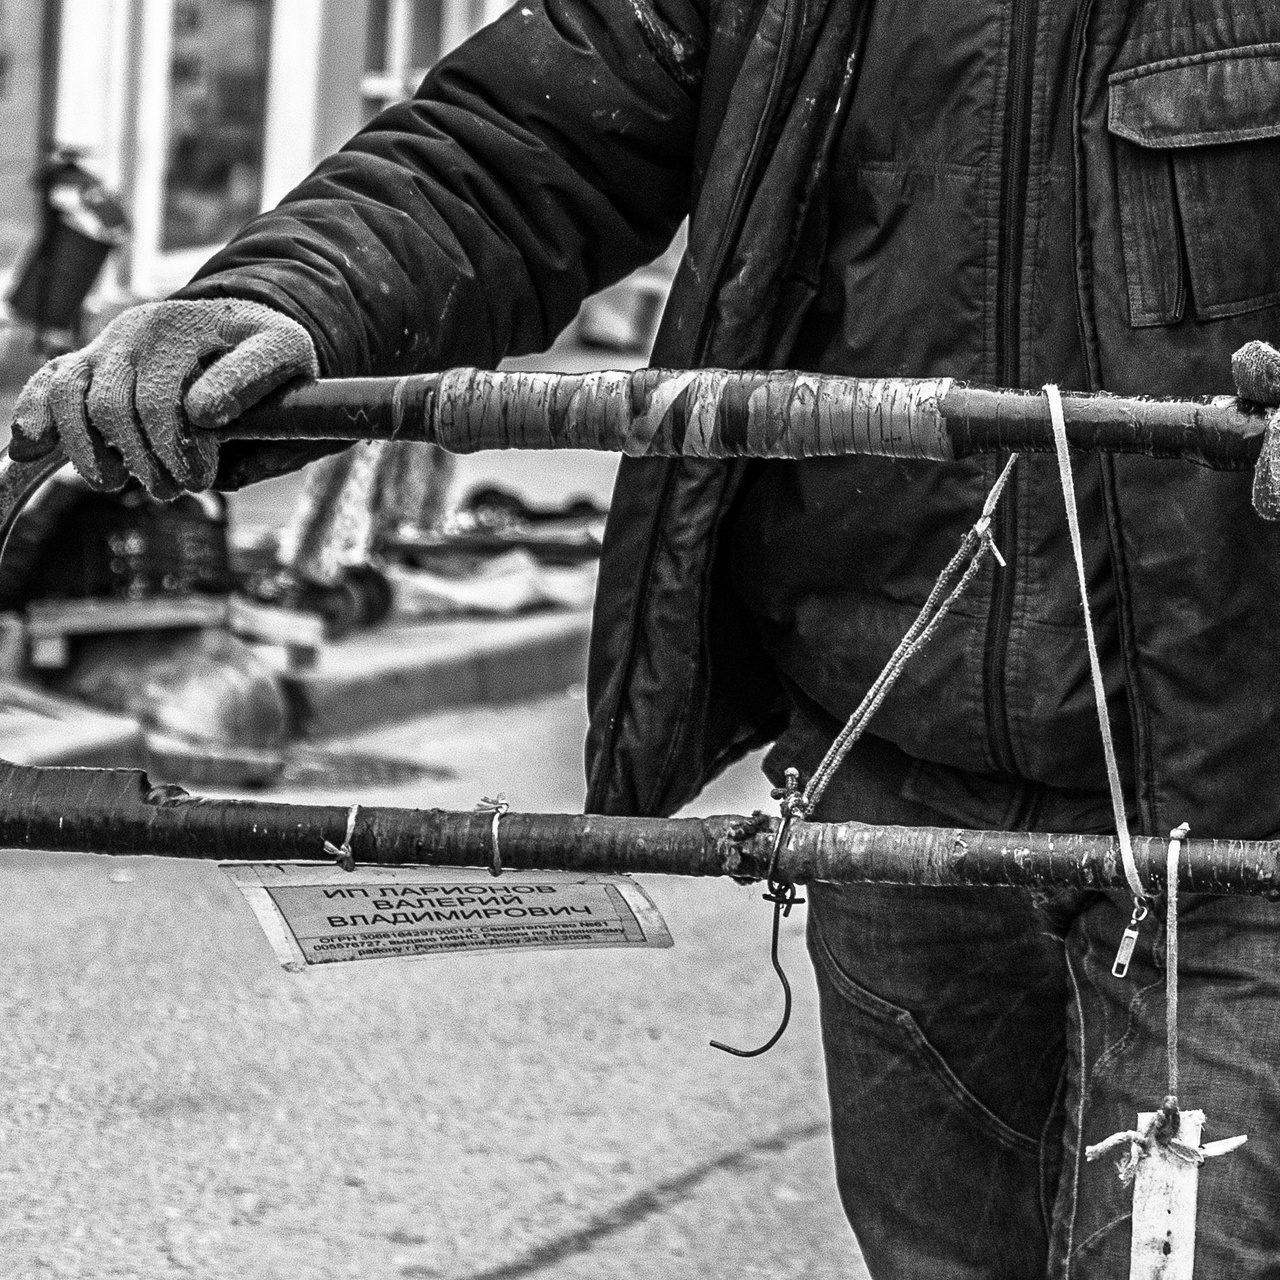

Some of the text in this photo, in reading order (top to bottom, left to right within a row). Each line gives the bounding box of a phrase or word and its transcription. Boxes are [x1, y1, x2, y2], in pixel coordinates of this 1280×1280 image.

[322, 885, 557, 899] ИП ЛАРИОНОВ
[372, 894, 523, 910] ВАЛЕРИЙ
[326, 905, 593, 928] ВЛАДИМИРОВИЧ
[319, 935, 357, 944] ОГРН
[439, 933, 479, 941] ИФНС
[550, 927, 626, 935] Ленинскому
